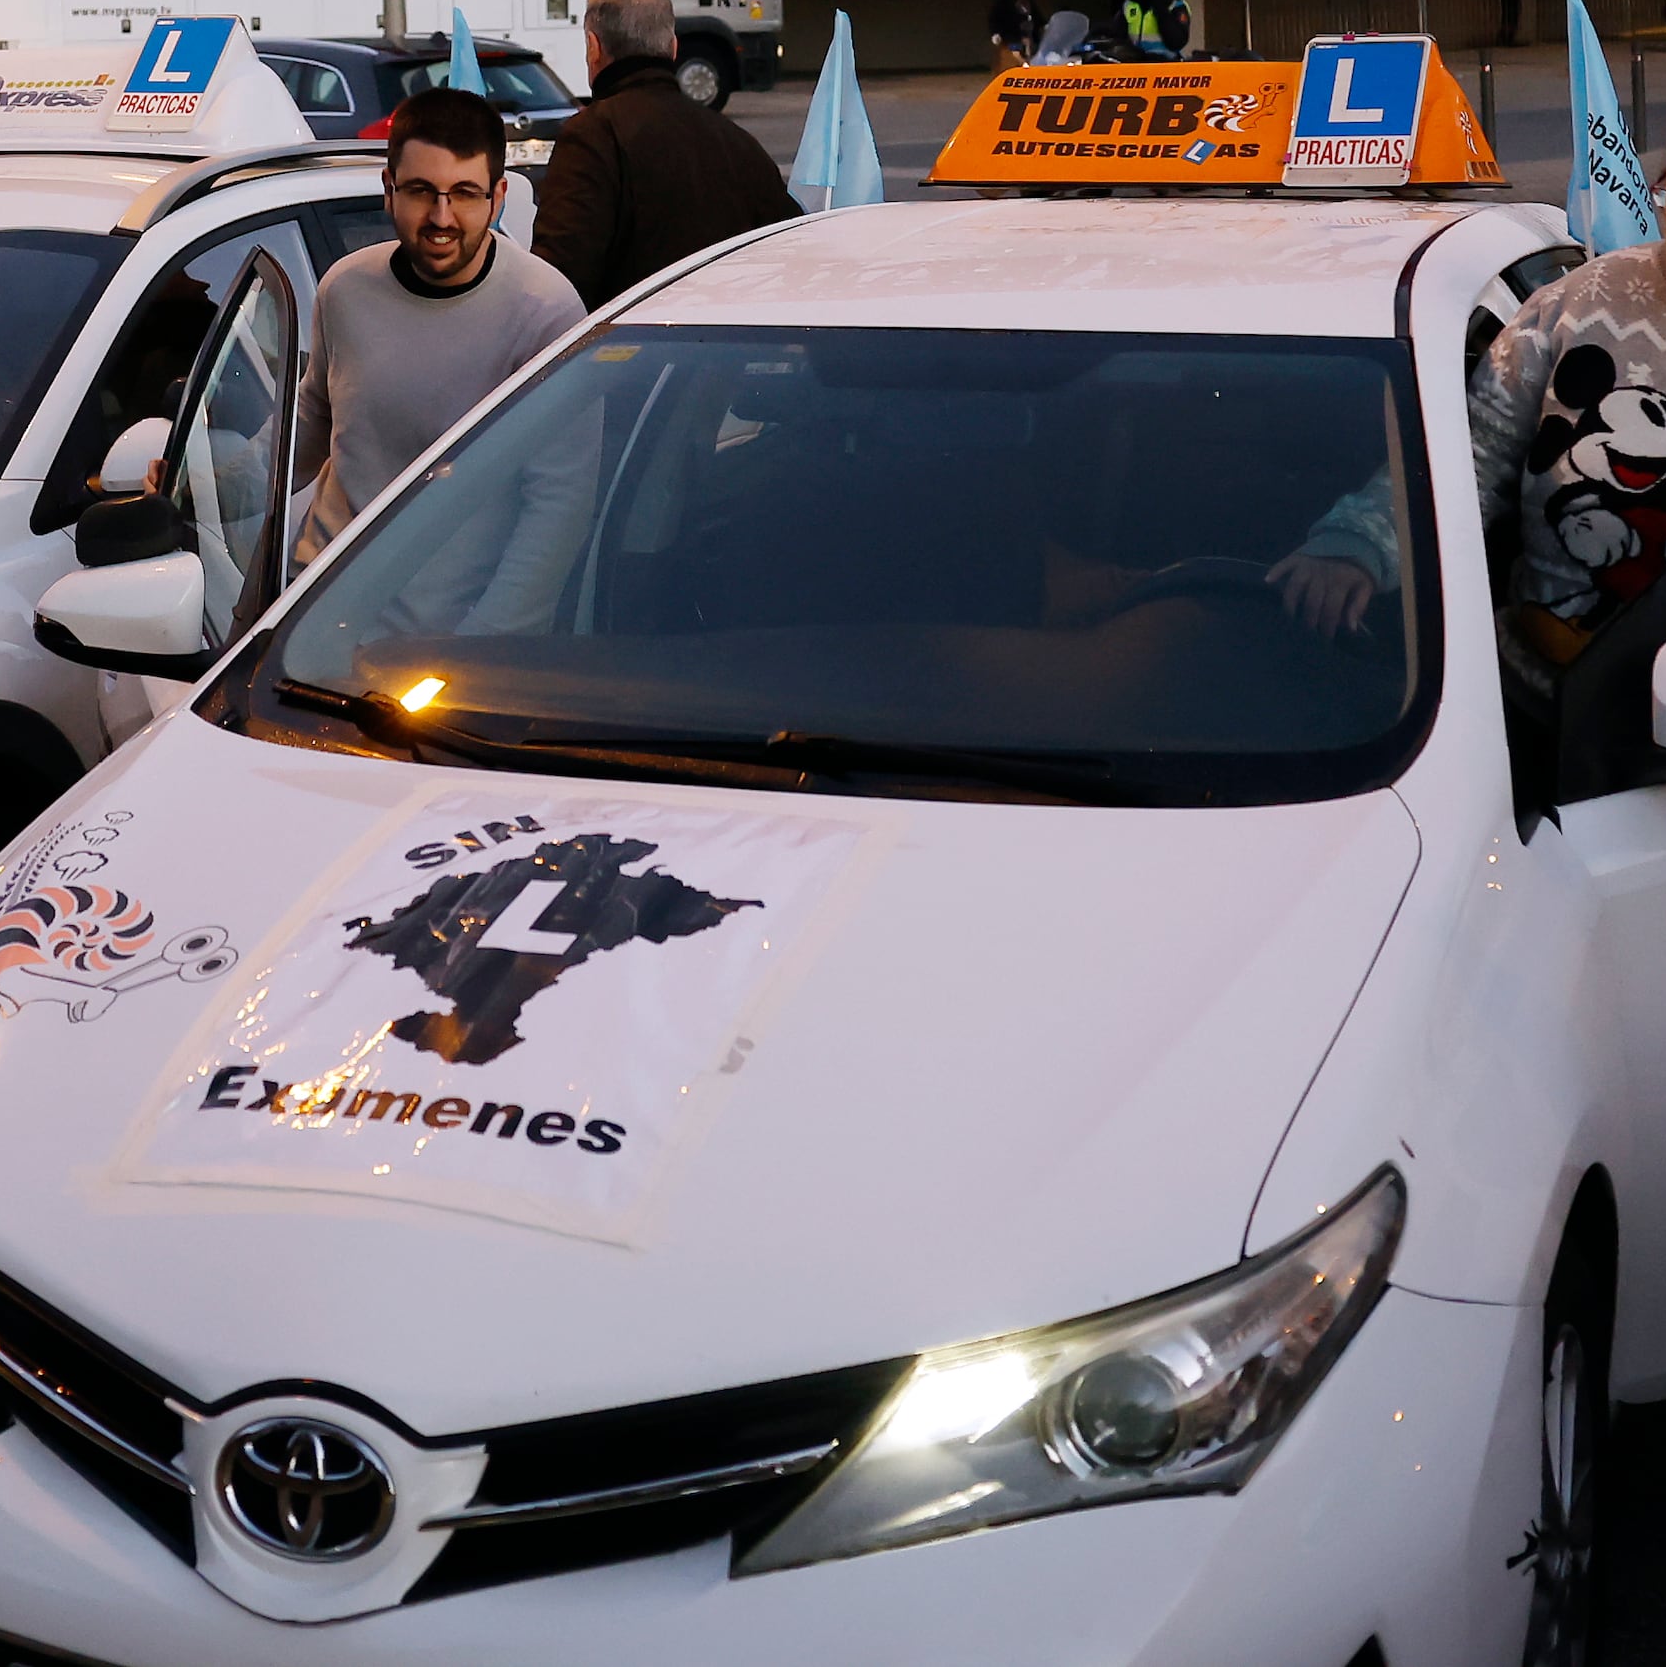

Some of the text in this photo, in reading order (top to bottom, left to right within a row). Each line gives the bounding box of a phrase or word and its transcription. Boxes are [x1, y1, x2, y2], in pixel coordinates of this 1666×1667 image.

[148, 30, 191, 82] L
[1152, 75, 1212, 89] MAYOR
[116, 94, 199, 115] PRACTICAS
[1328, 57, 1384, 123] L
[1293, 138, 1406, 166] PRACTICAS
[1589, 149, 1648, 236] Navarra
[405, 815, 546, 870] SIN
